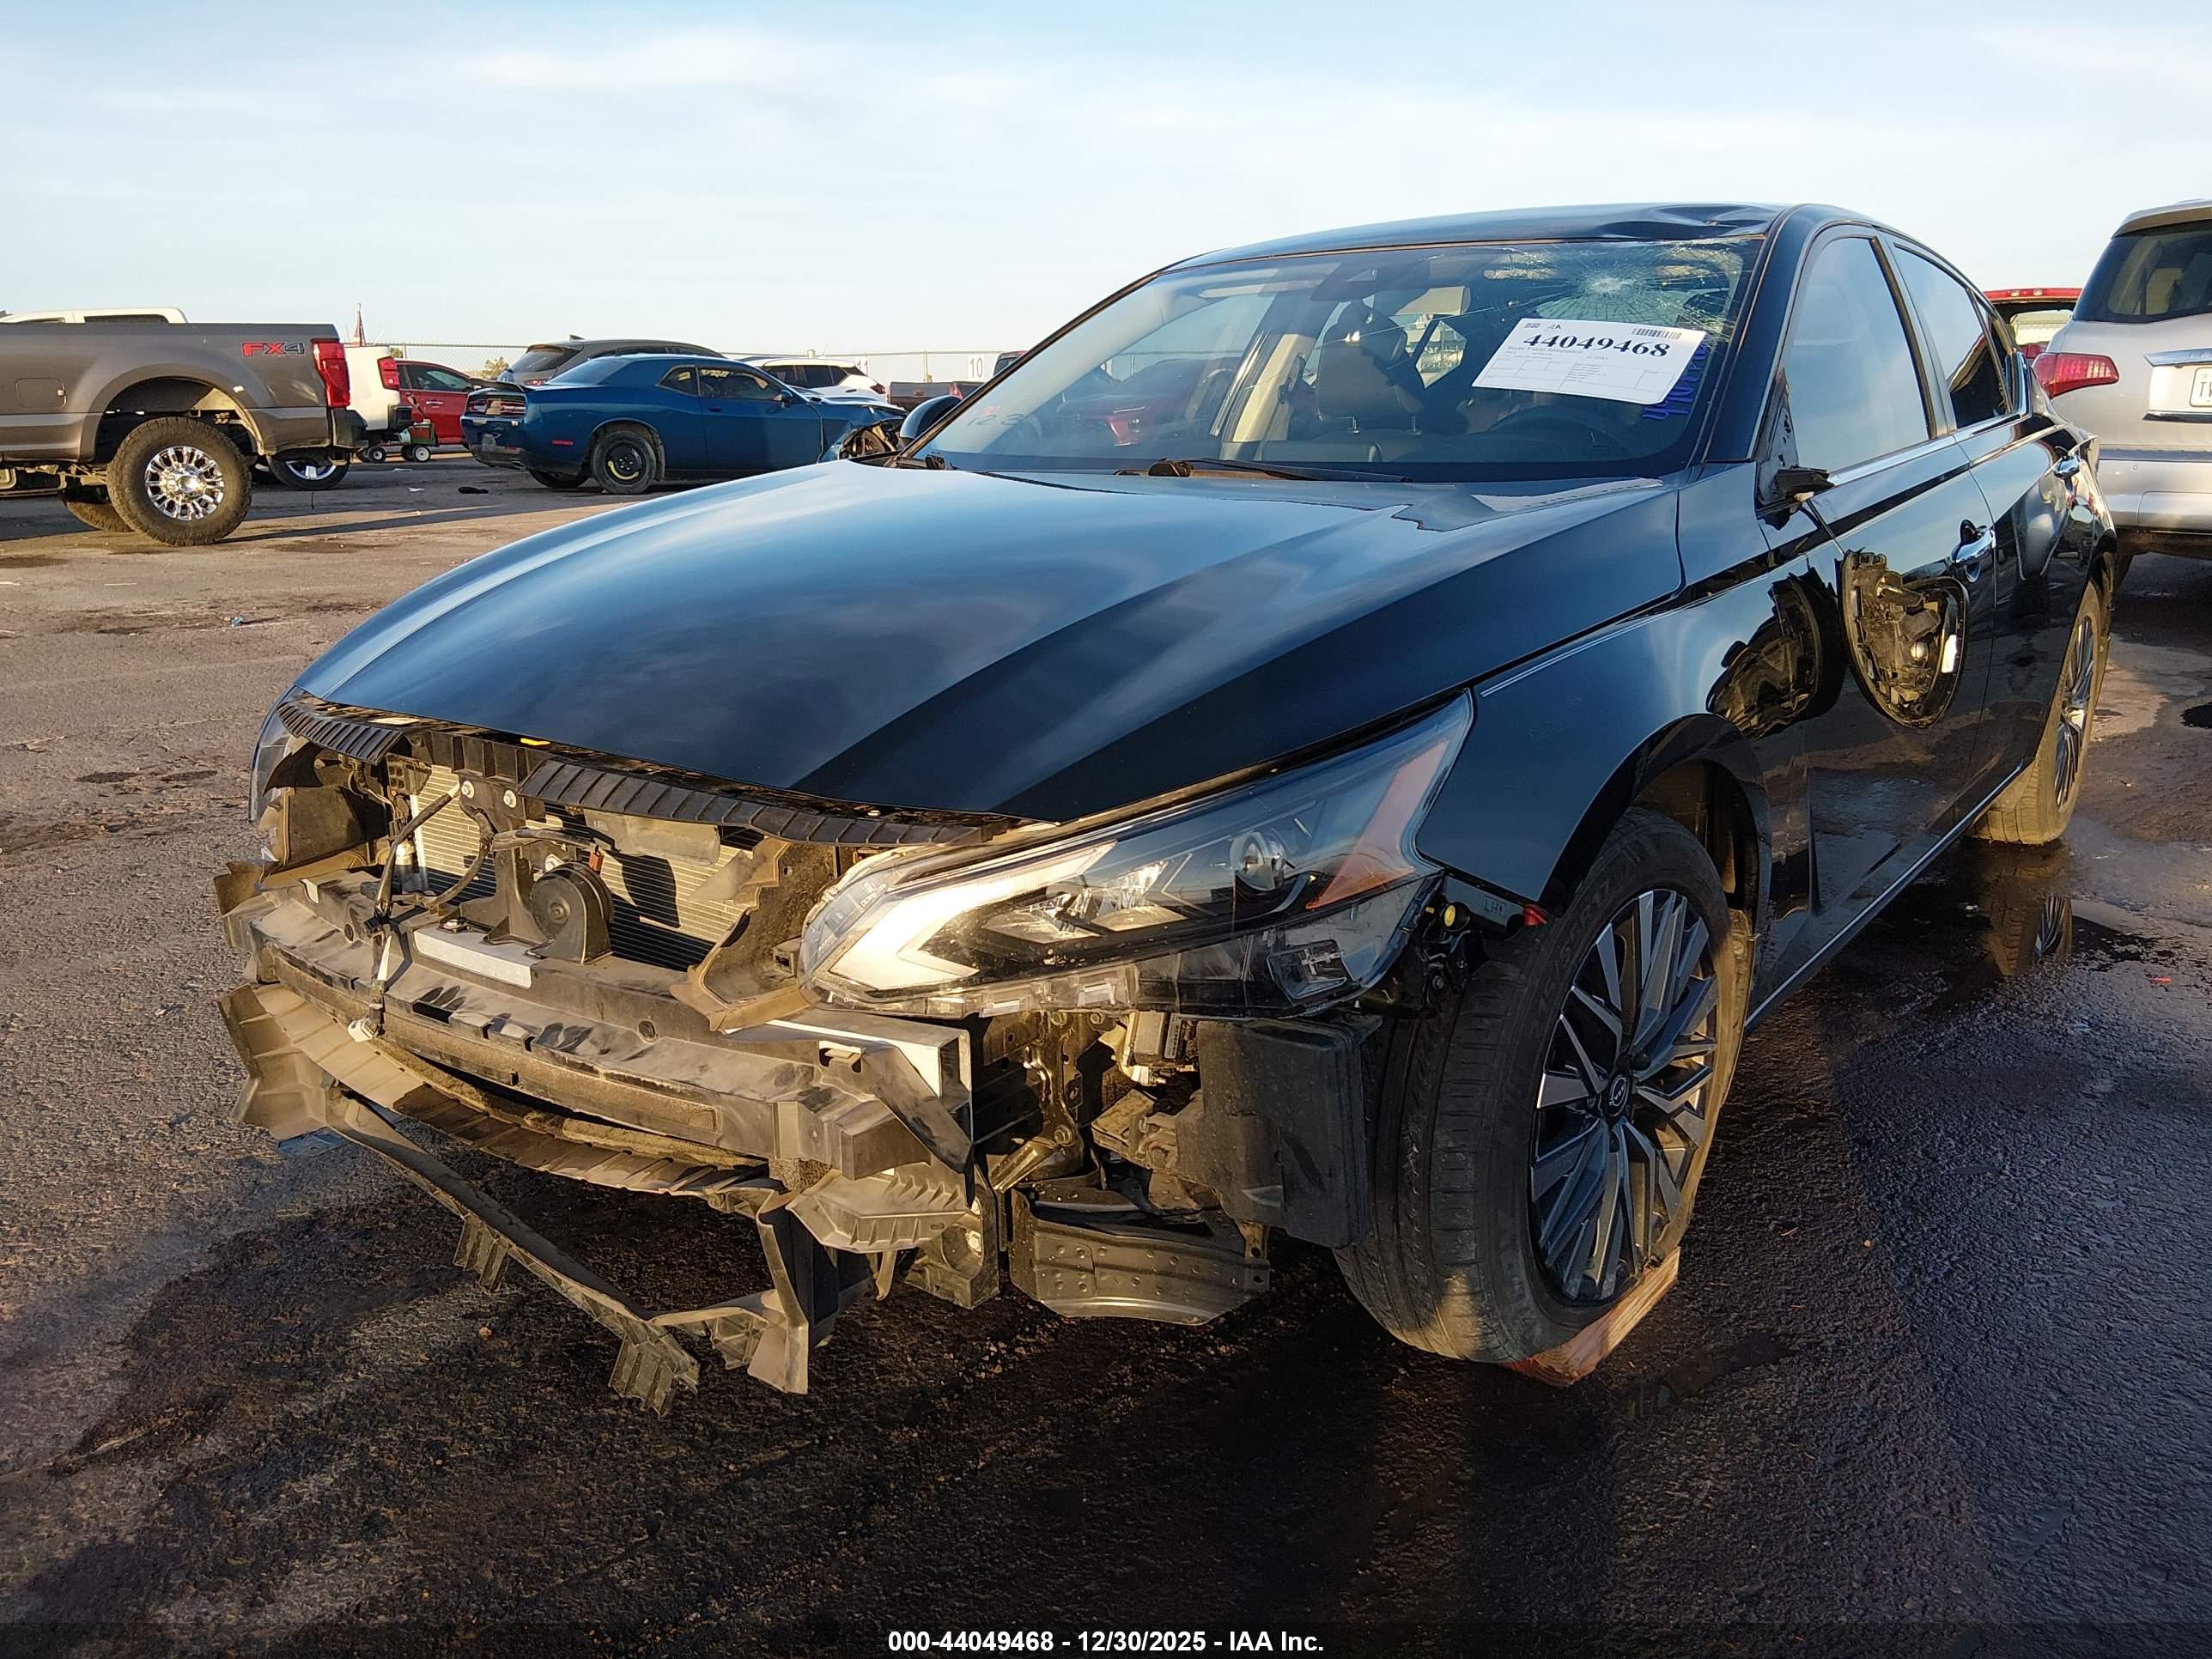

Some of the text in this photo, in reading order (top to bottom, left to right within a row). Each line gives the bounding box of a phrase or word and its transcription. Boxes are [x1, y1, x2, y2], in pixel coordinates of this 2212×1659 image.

[242, 342, 305, 357] FX4
[1523, 334, 1670, 356] 44049468
[969, 357, 984, 379] 10
